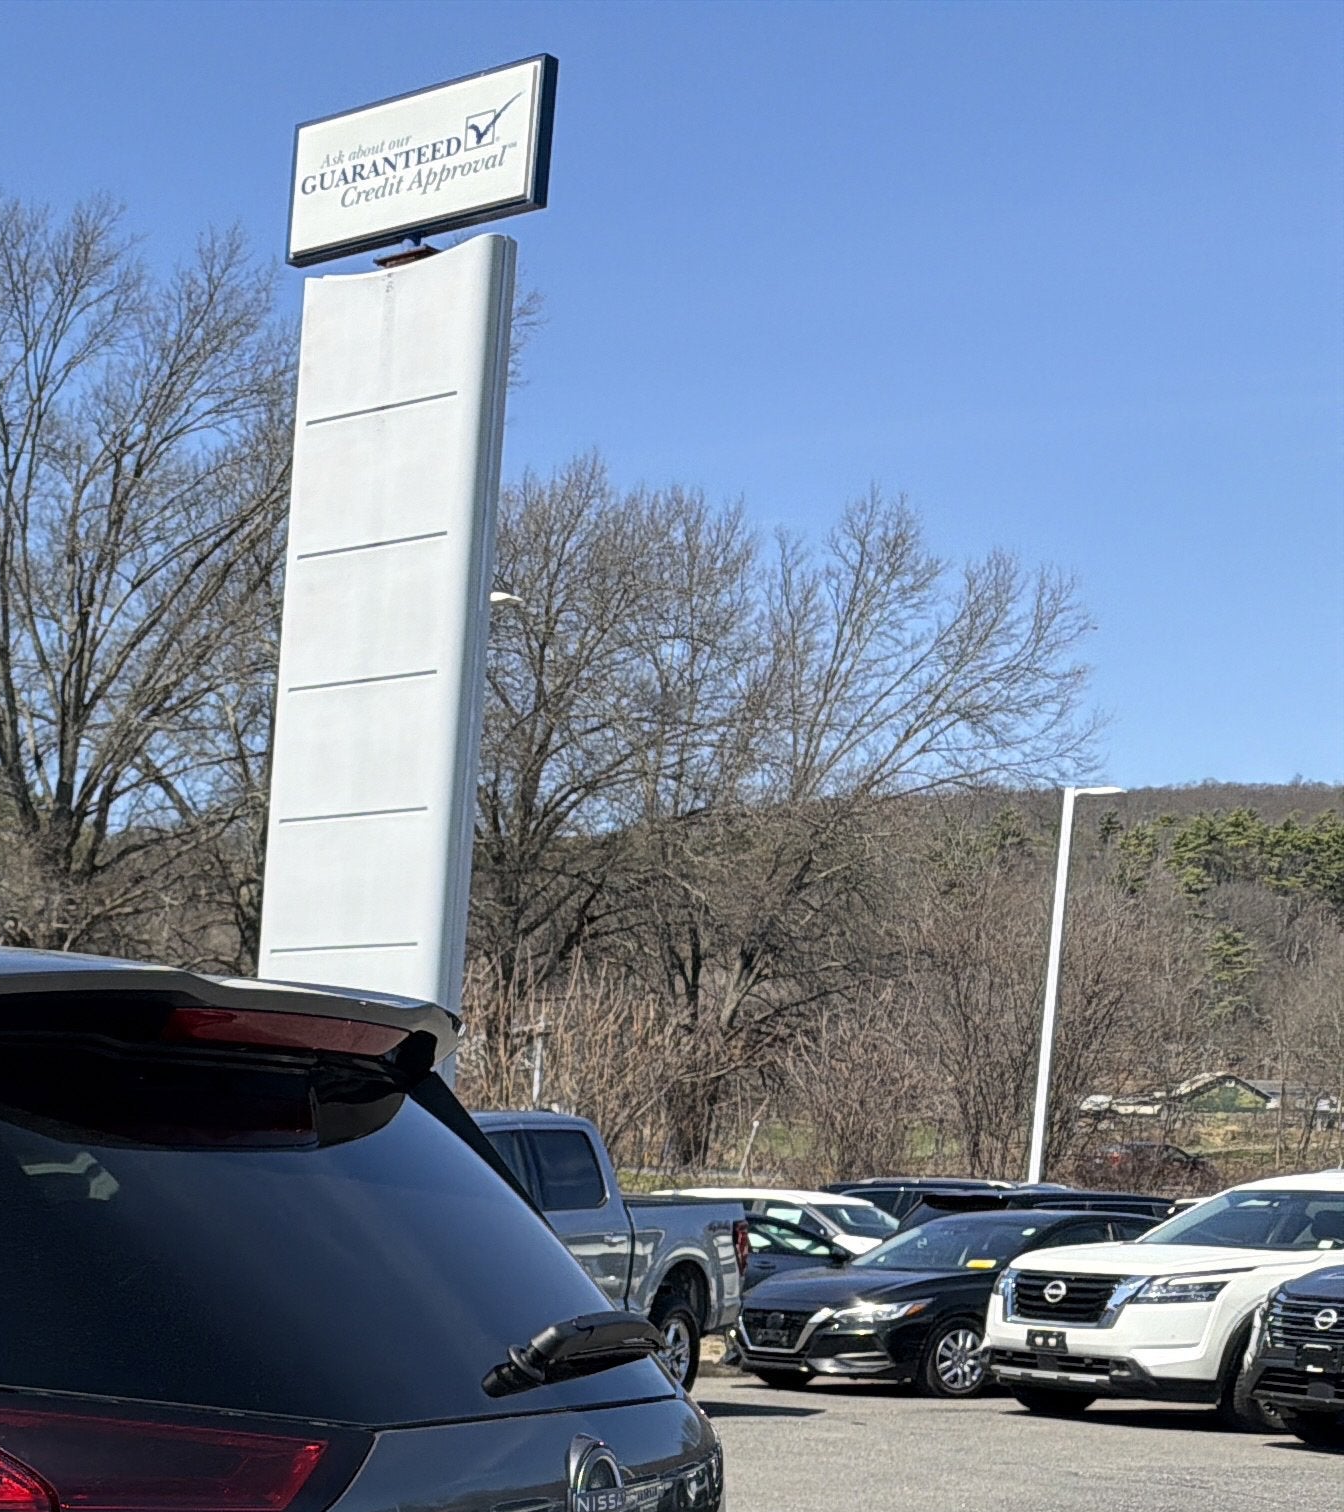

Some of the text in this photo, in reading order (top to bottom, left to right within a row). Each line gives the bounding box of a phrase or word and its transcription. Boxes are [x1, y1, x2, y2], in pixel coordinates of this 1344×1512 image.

[301, 137, 462, 195] GUARANTEED
[321, 135, 412, 169] Ask about our
[340, 145, 506, 208] Credit Approval
